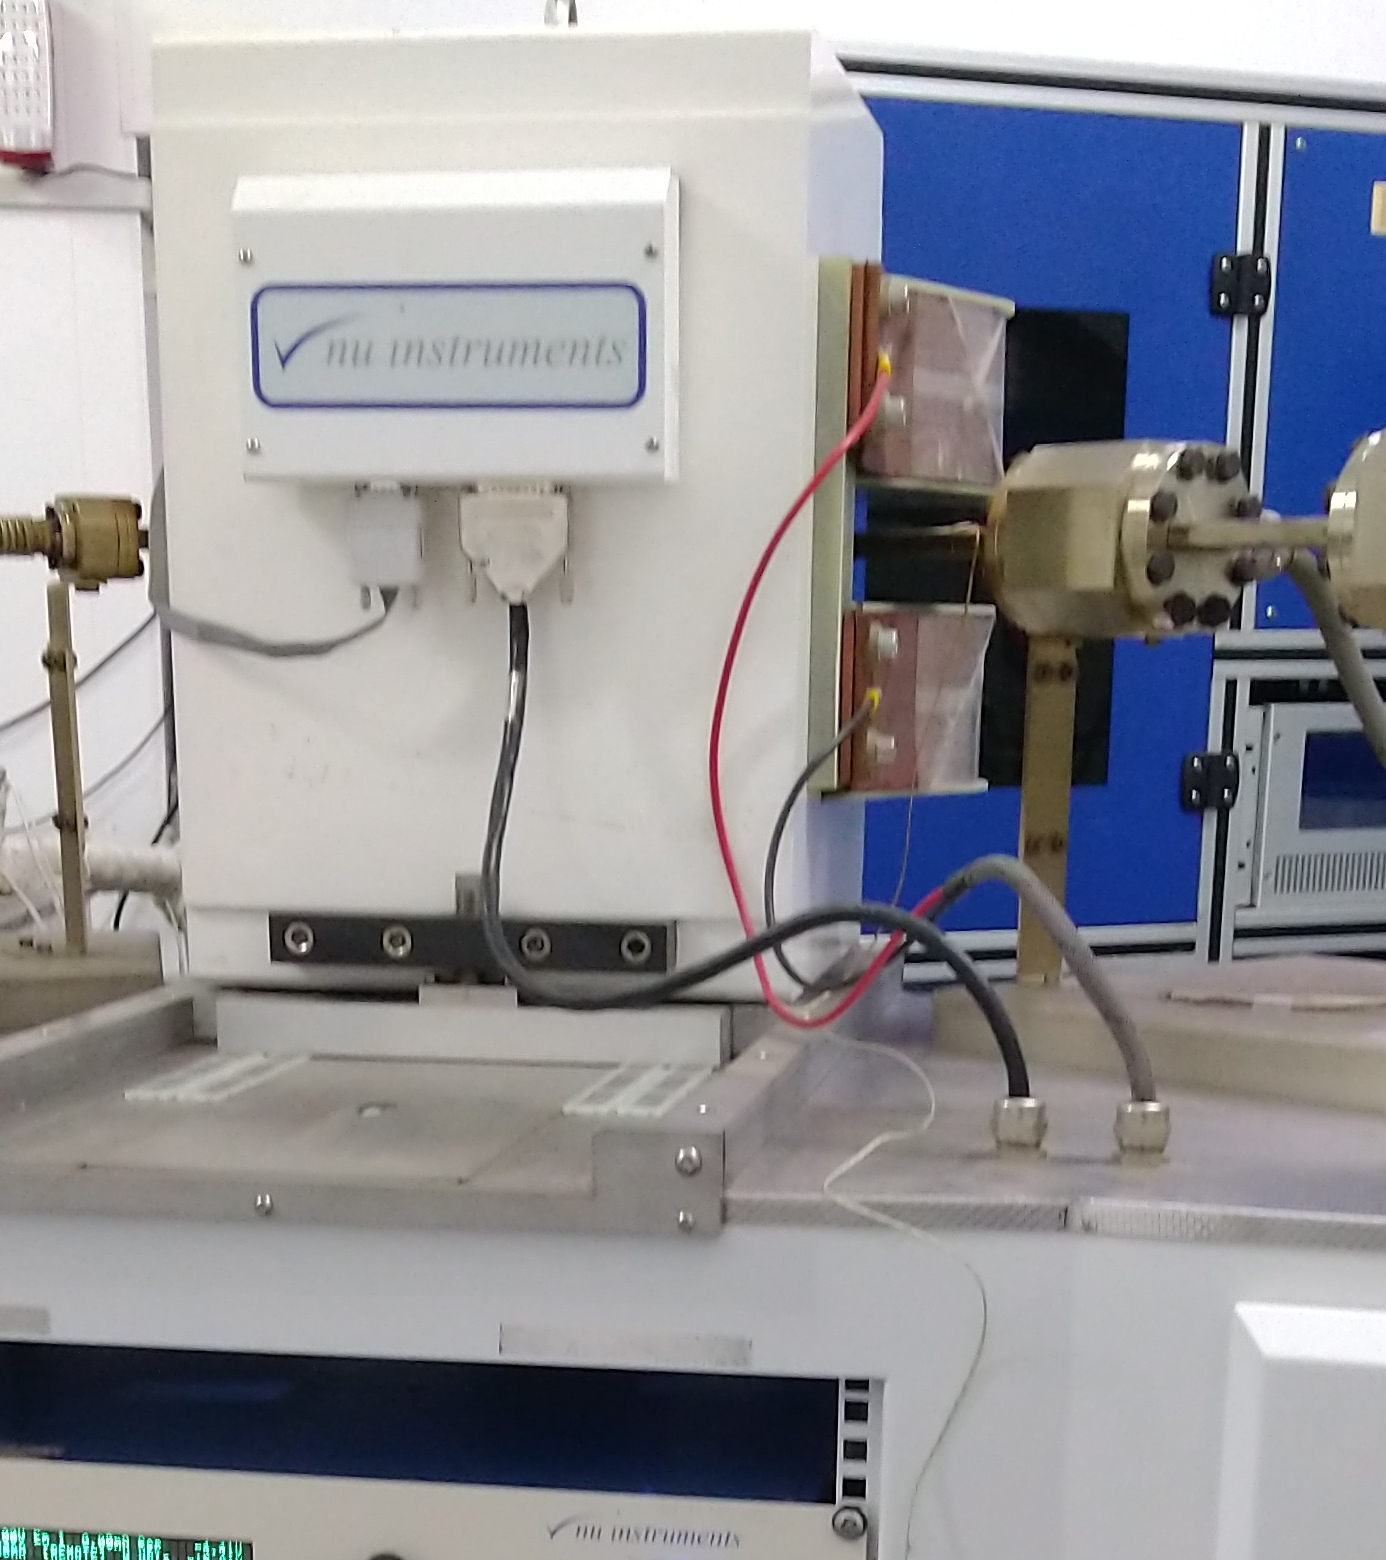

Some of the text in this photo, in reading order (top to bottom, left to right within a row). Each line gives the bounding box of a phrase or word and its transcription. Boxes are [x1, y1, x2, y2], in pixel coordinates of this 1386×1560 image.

[324, 328, 628, 370] nu instruments
[611, 1524, 740, 1549] instruments
